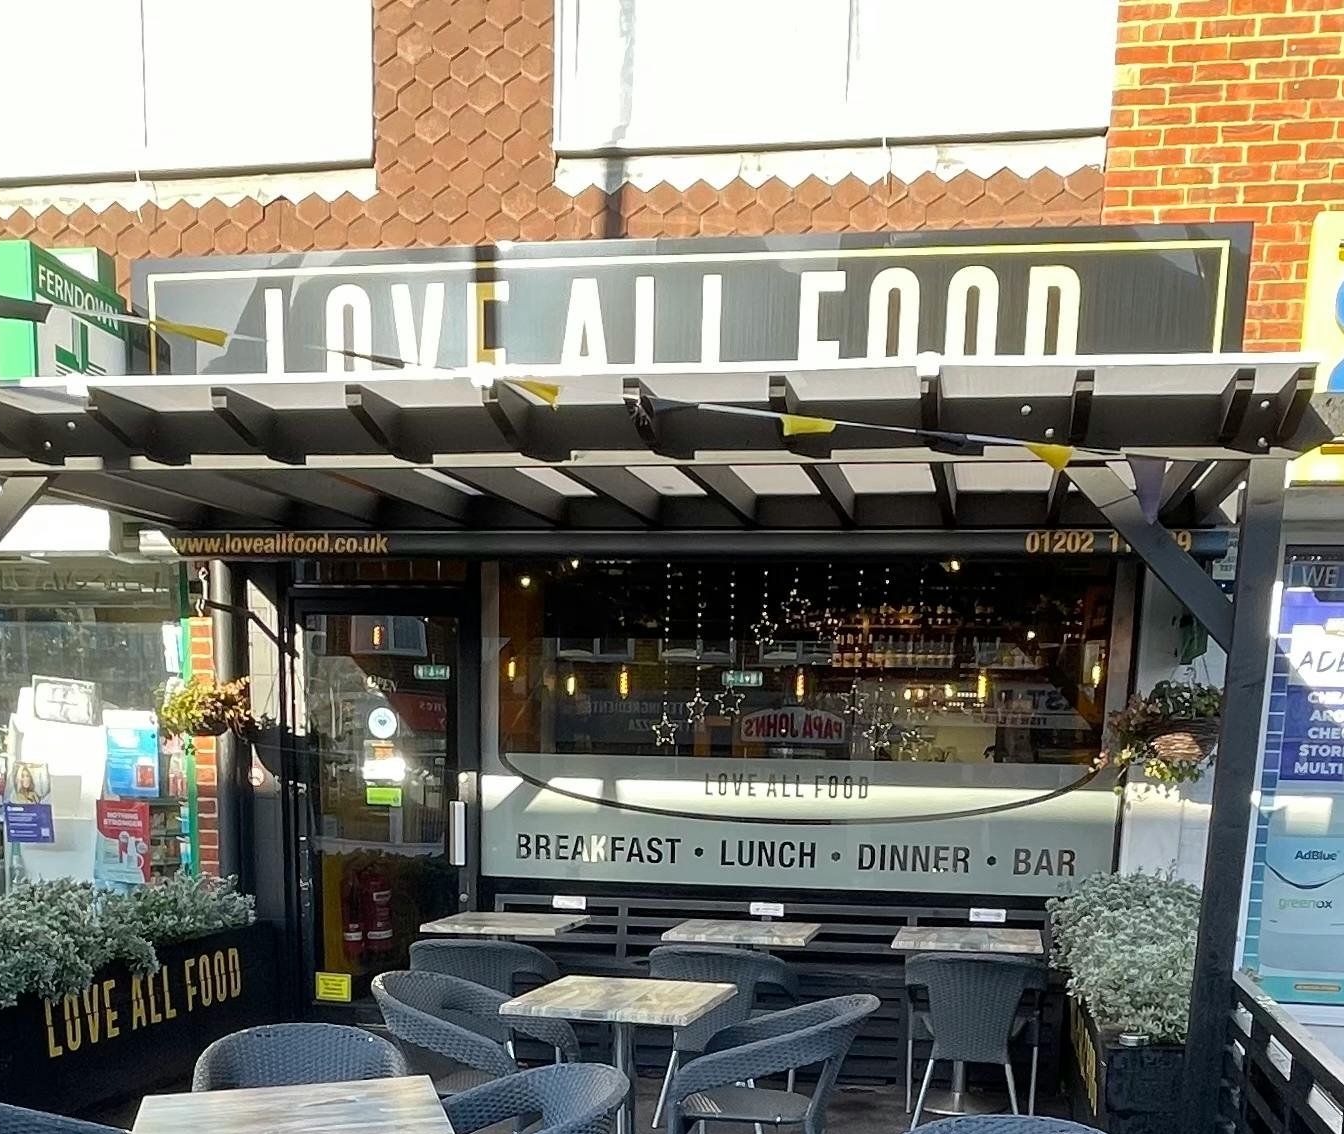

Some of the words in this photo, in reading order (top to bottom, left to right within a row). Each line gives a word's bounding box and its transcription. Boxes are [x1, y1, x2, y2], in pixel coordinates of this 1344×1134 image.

[38, 264, 118, 331] FERNDOWN
[264, 280, 510, 374] LOVE
[798, 264, 1081, 362] FOOD
[171, 533, 388, 554] www.loveallfood.co.uk
[1025, 530, 1095, 554] 01202
[1302, 566, 1340, 587] WE
[366, 674, 399, 693] OPEN
[704, 772, 758, 798] LOVE
[766, 774, 805, 799] ALL
[814, 775, 870, 800] FOOD
[516, 832, 682, 865] BREAKFAST
[719, 839, 817, 868] LUNCH
[857, 843, 971, 874] DINNER
[1012, 848, 1076, 877] BAR
[1294, 849, 1338, 861] AdBlue
[1278, 898, 1333, 911] greenox
[44, 978, 121, 1059] LOVE
[131, 964, 178, 1031] ALL
[184, 947, 243, 1013] FOOD
